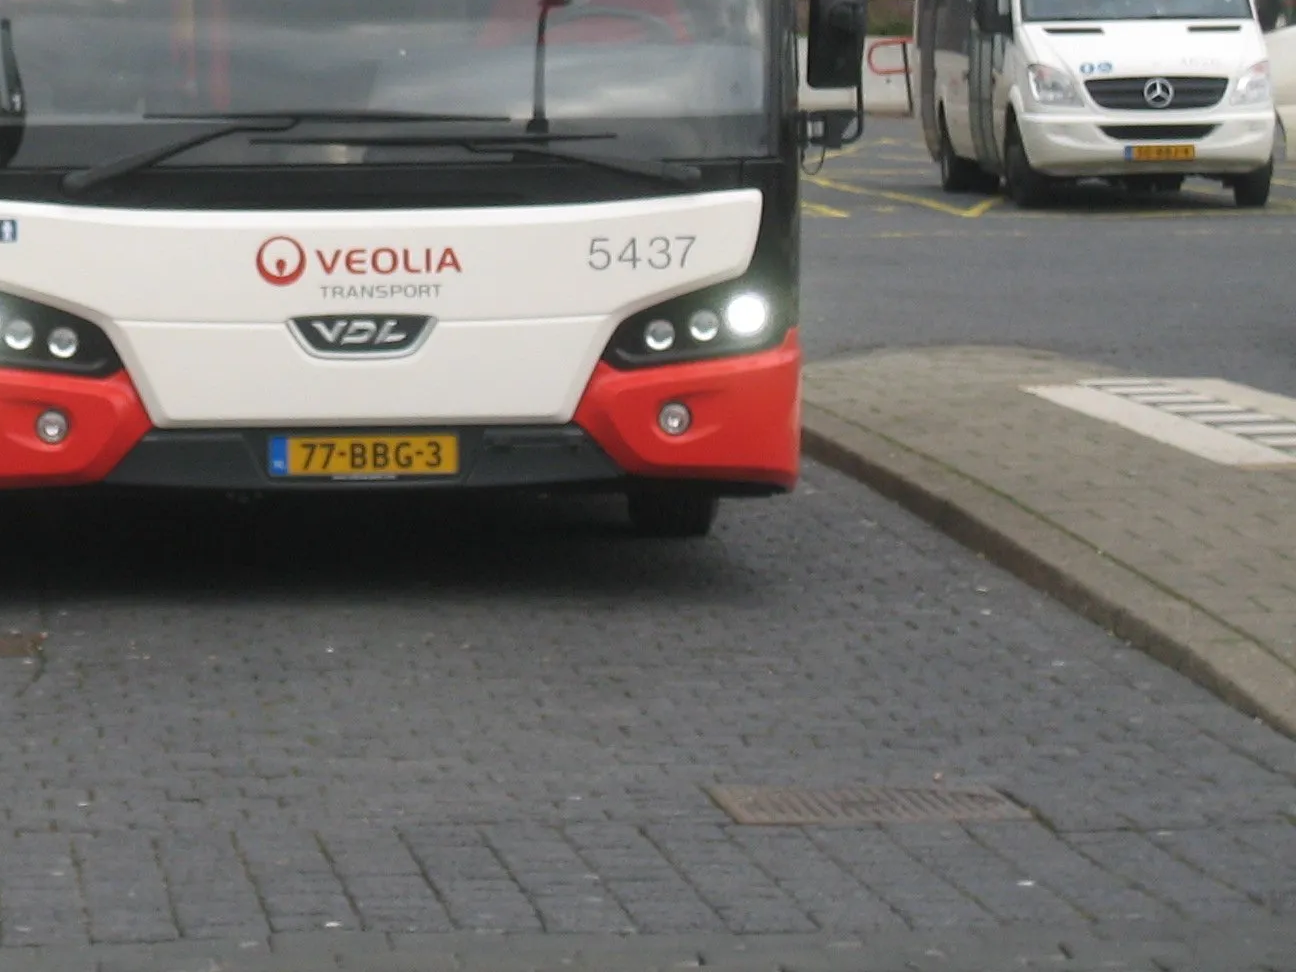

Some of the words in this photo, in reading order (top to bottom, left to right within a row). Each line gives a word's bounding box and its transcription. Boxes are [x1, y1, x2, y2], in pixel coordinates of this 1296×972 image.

[315, 247, 463, 275] VEOLIA
[588, 235, 697, 270] 5437
[320, 284, 442, 300] TRANSPORT
[310, 319, 407, 346] VDL
[300, 440, 443, 470] 77-BBG-3
